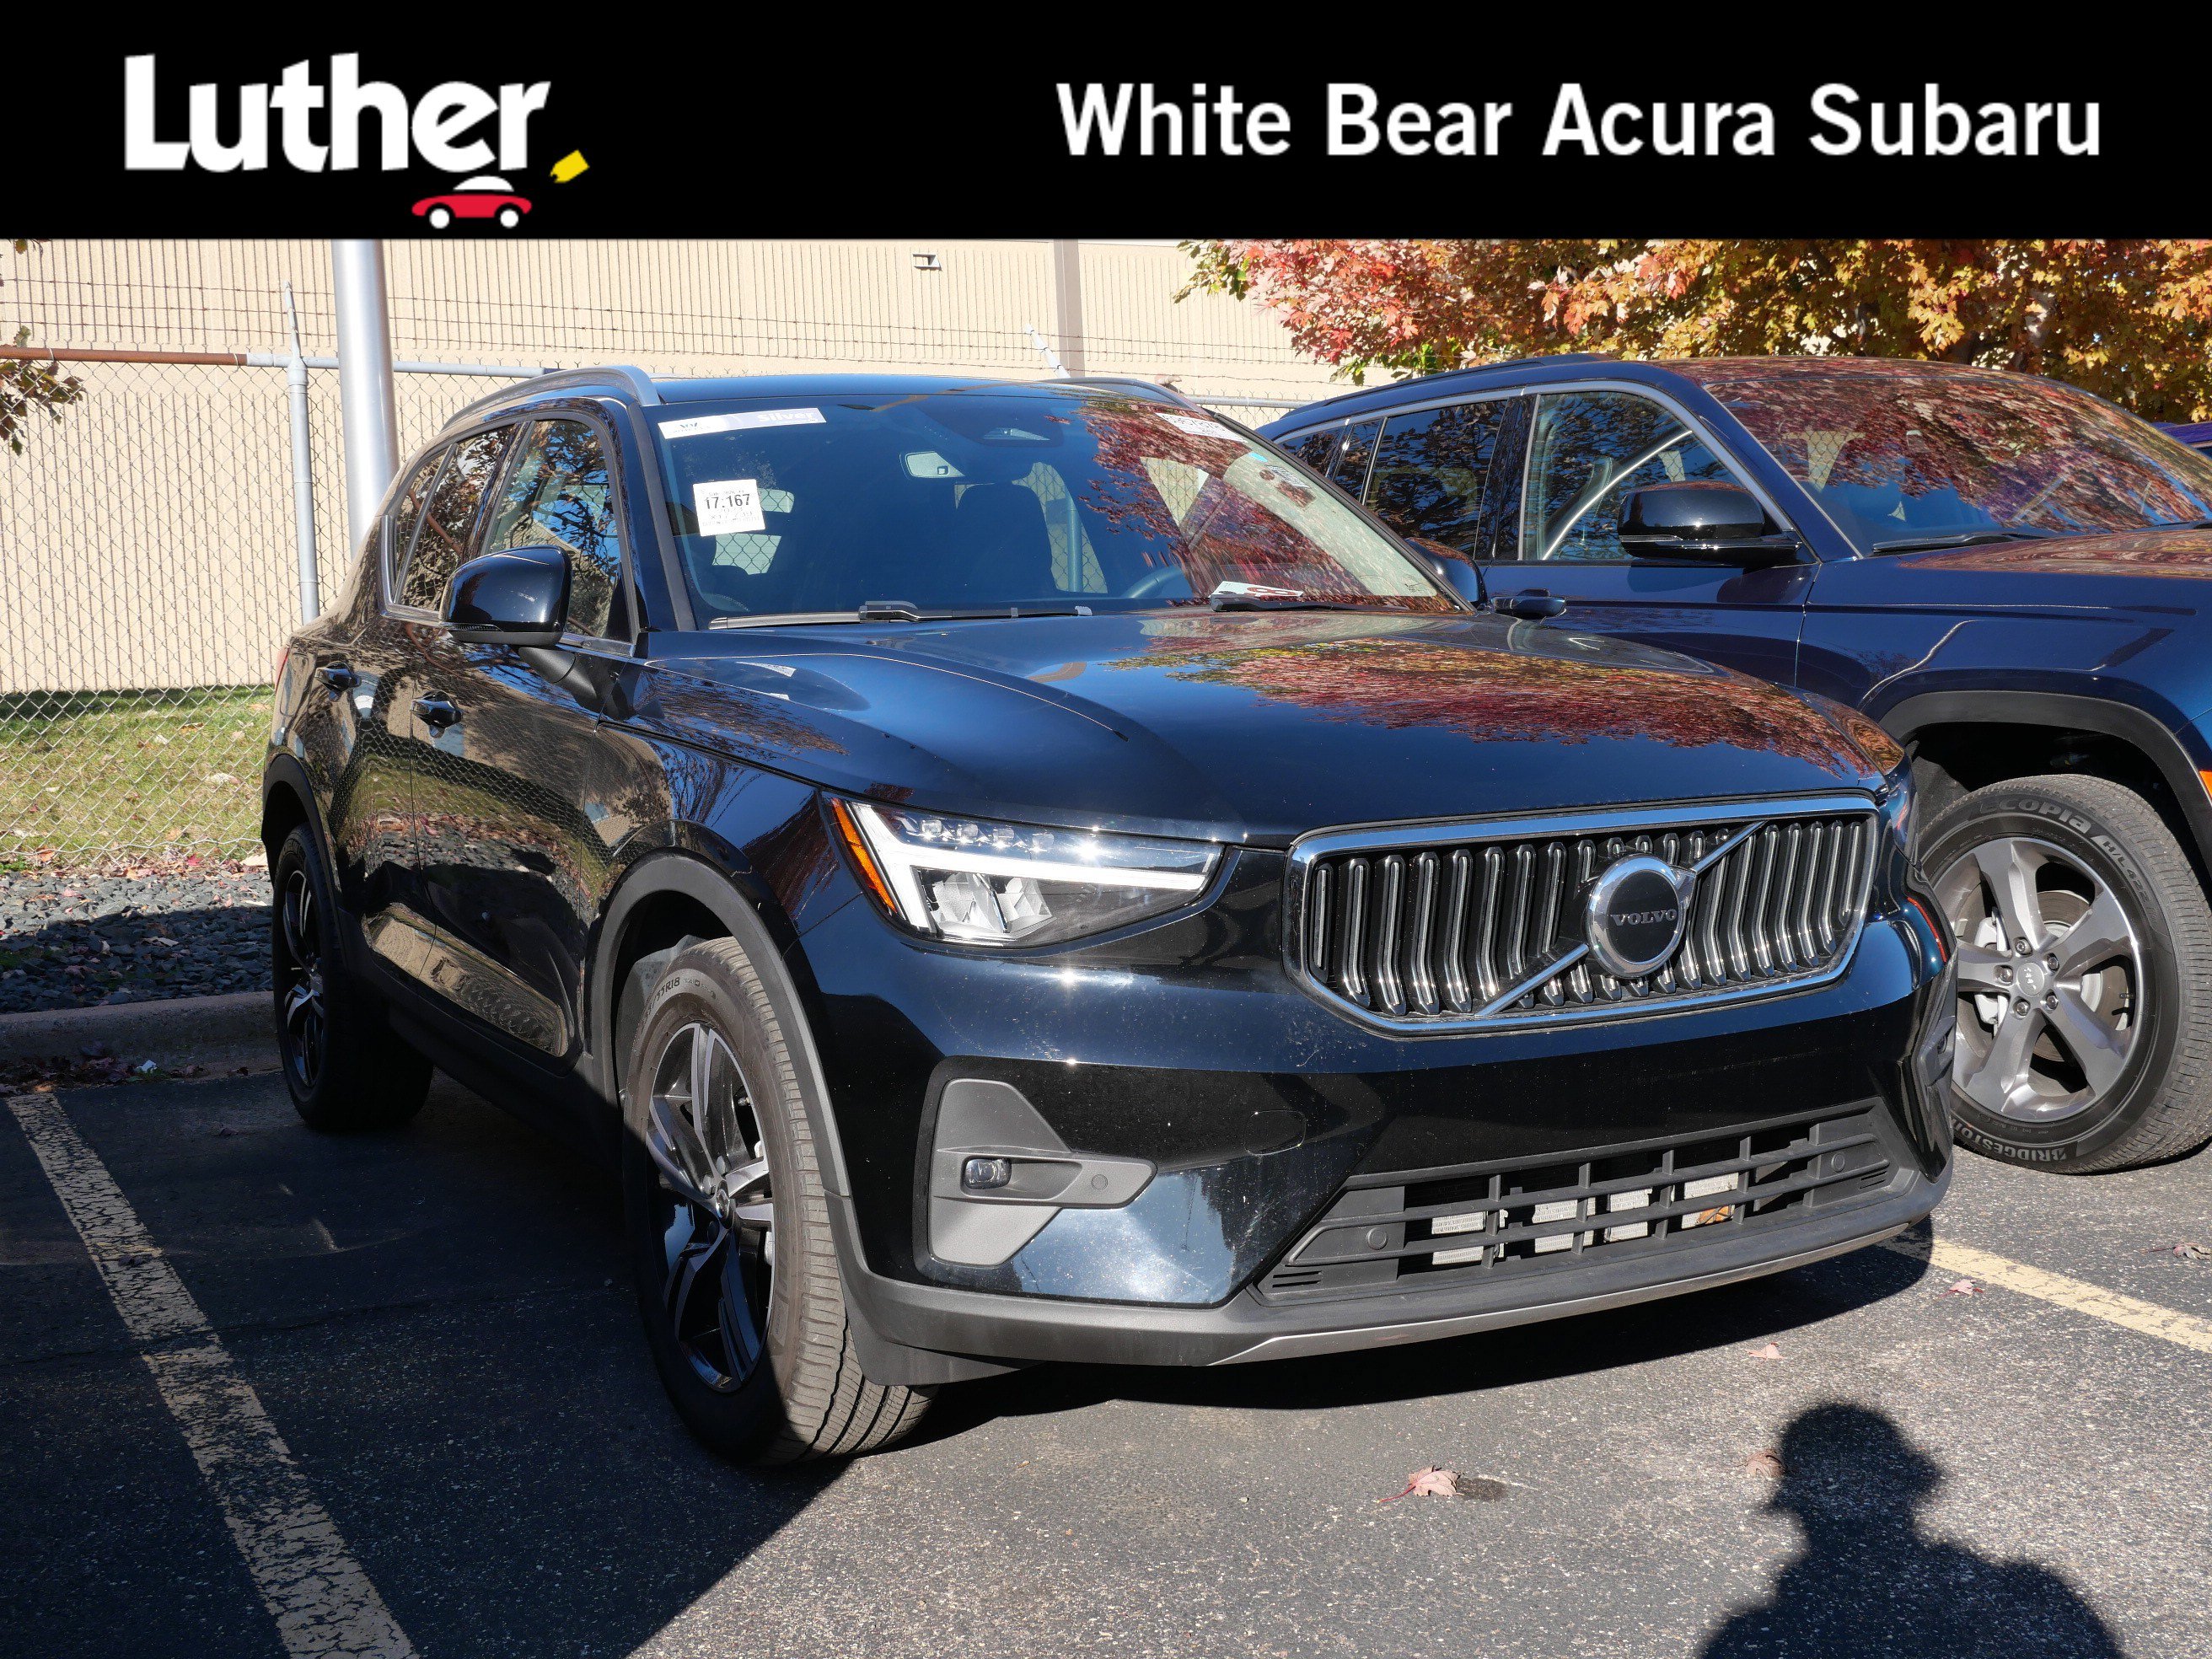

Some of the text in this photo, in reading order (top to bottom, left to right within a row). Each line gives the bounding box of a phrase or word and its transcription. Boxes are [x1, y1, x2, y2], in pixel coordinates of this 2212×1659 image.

[757, 411, 815, 423] Silver
[1610, 908, 1678, 926] VOLVO
[1950, 1117, 2067, 1162] BRIDGESTON
